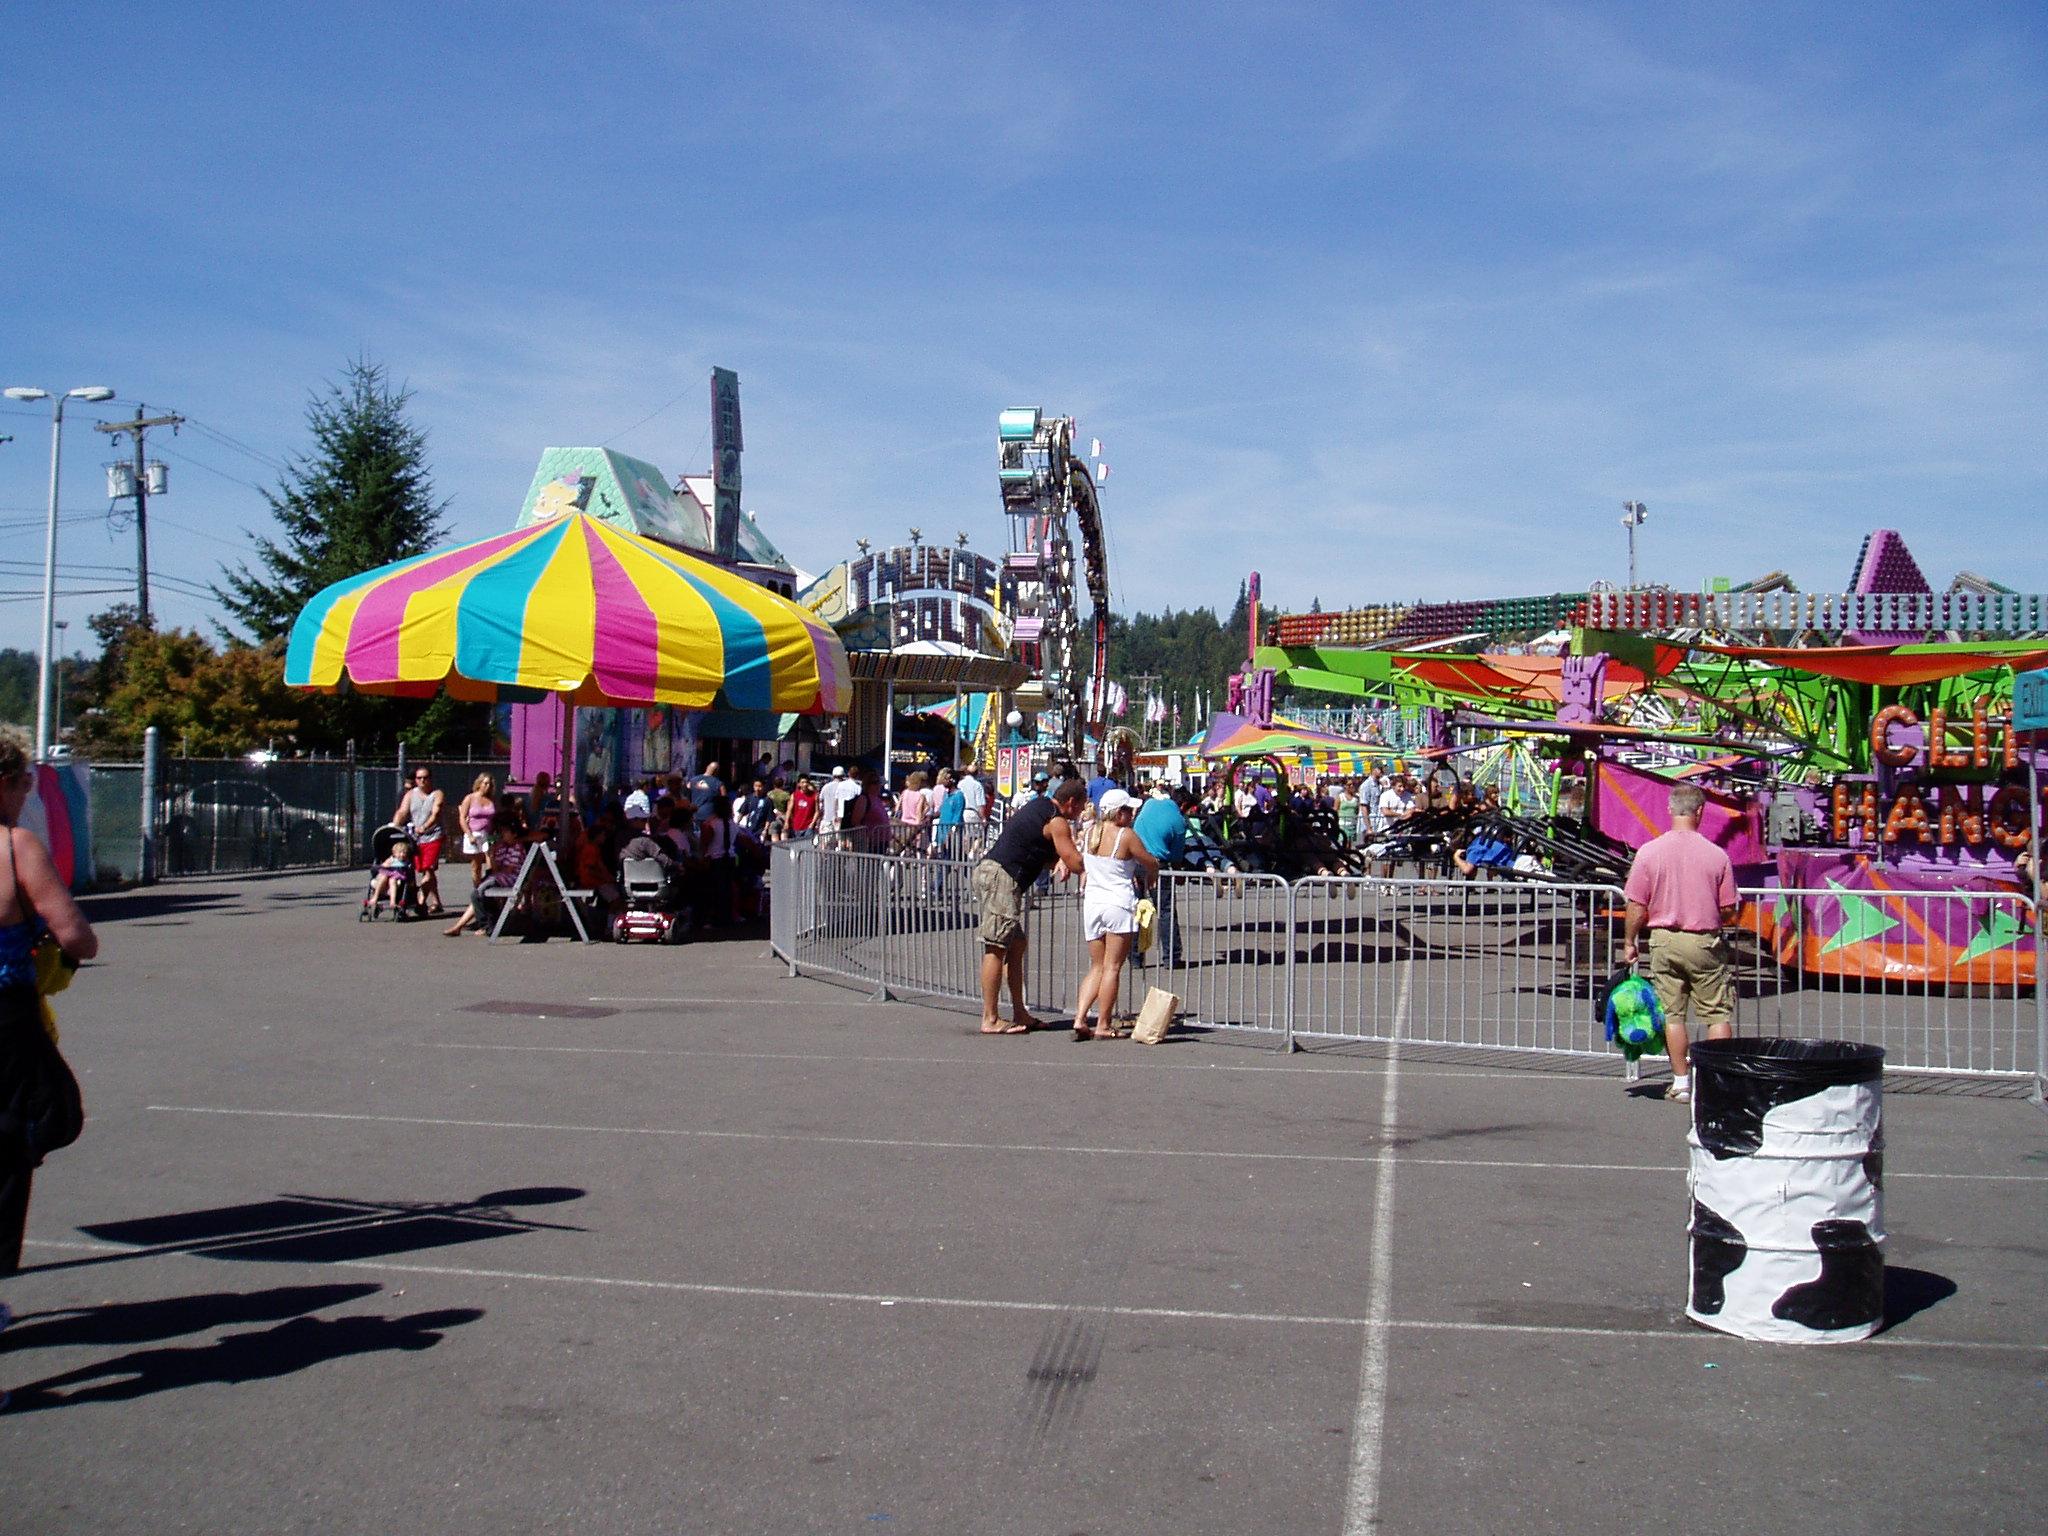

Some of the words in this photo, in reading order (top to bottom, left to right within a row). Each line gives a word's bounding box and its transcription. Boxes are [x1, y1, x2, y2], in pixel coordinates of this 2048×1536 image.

[851, 546, 1018, 610] THUNDER
[893, 597, 981, 649] BOLT
[1833, 783, 2048, 847] HANG
